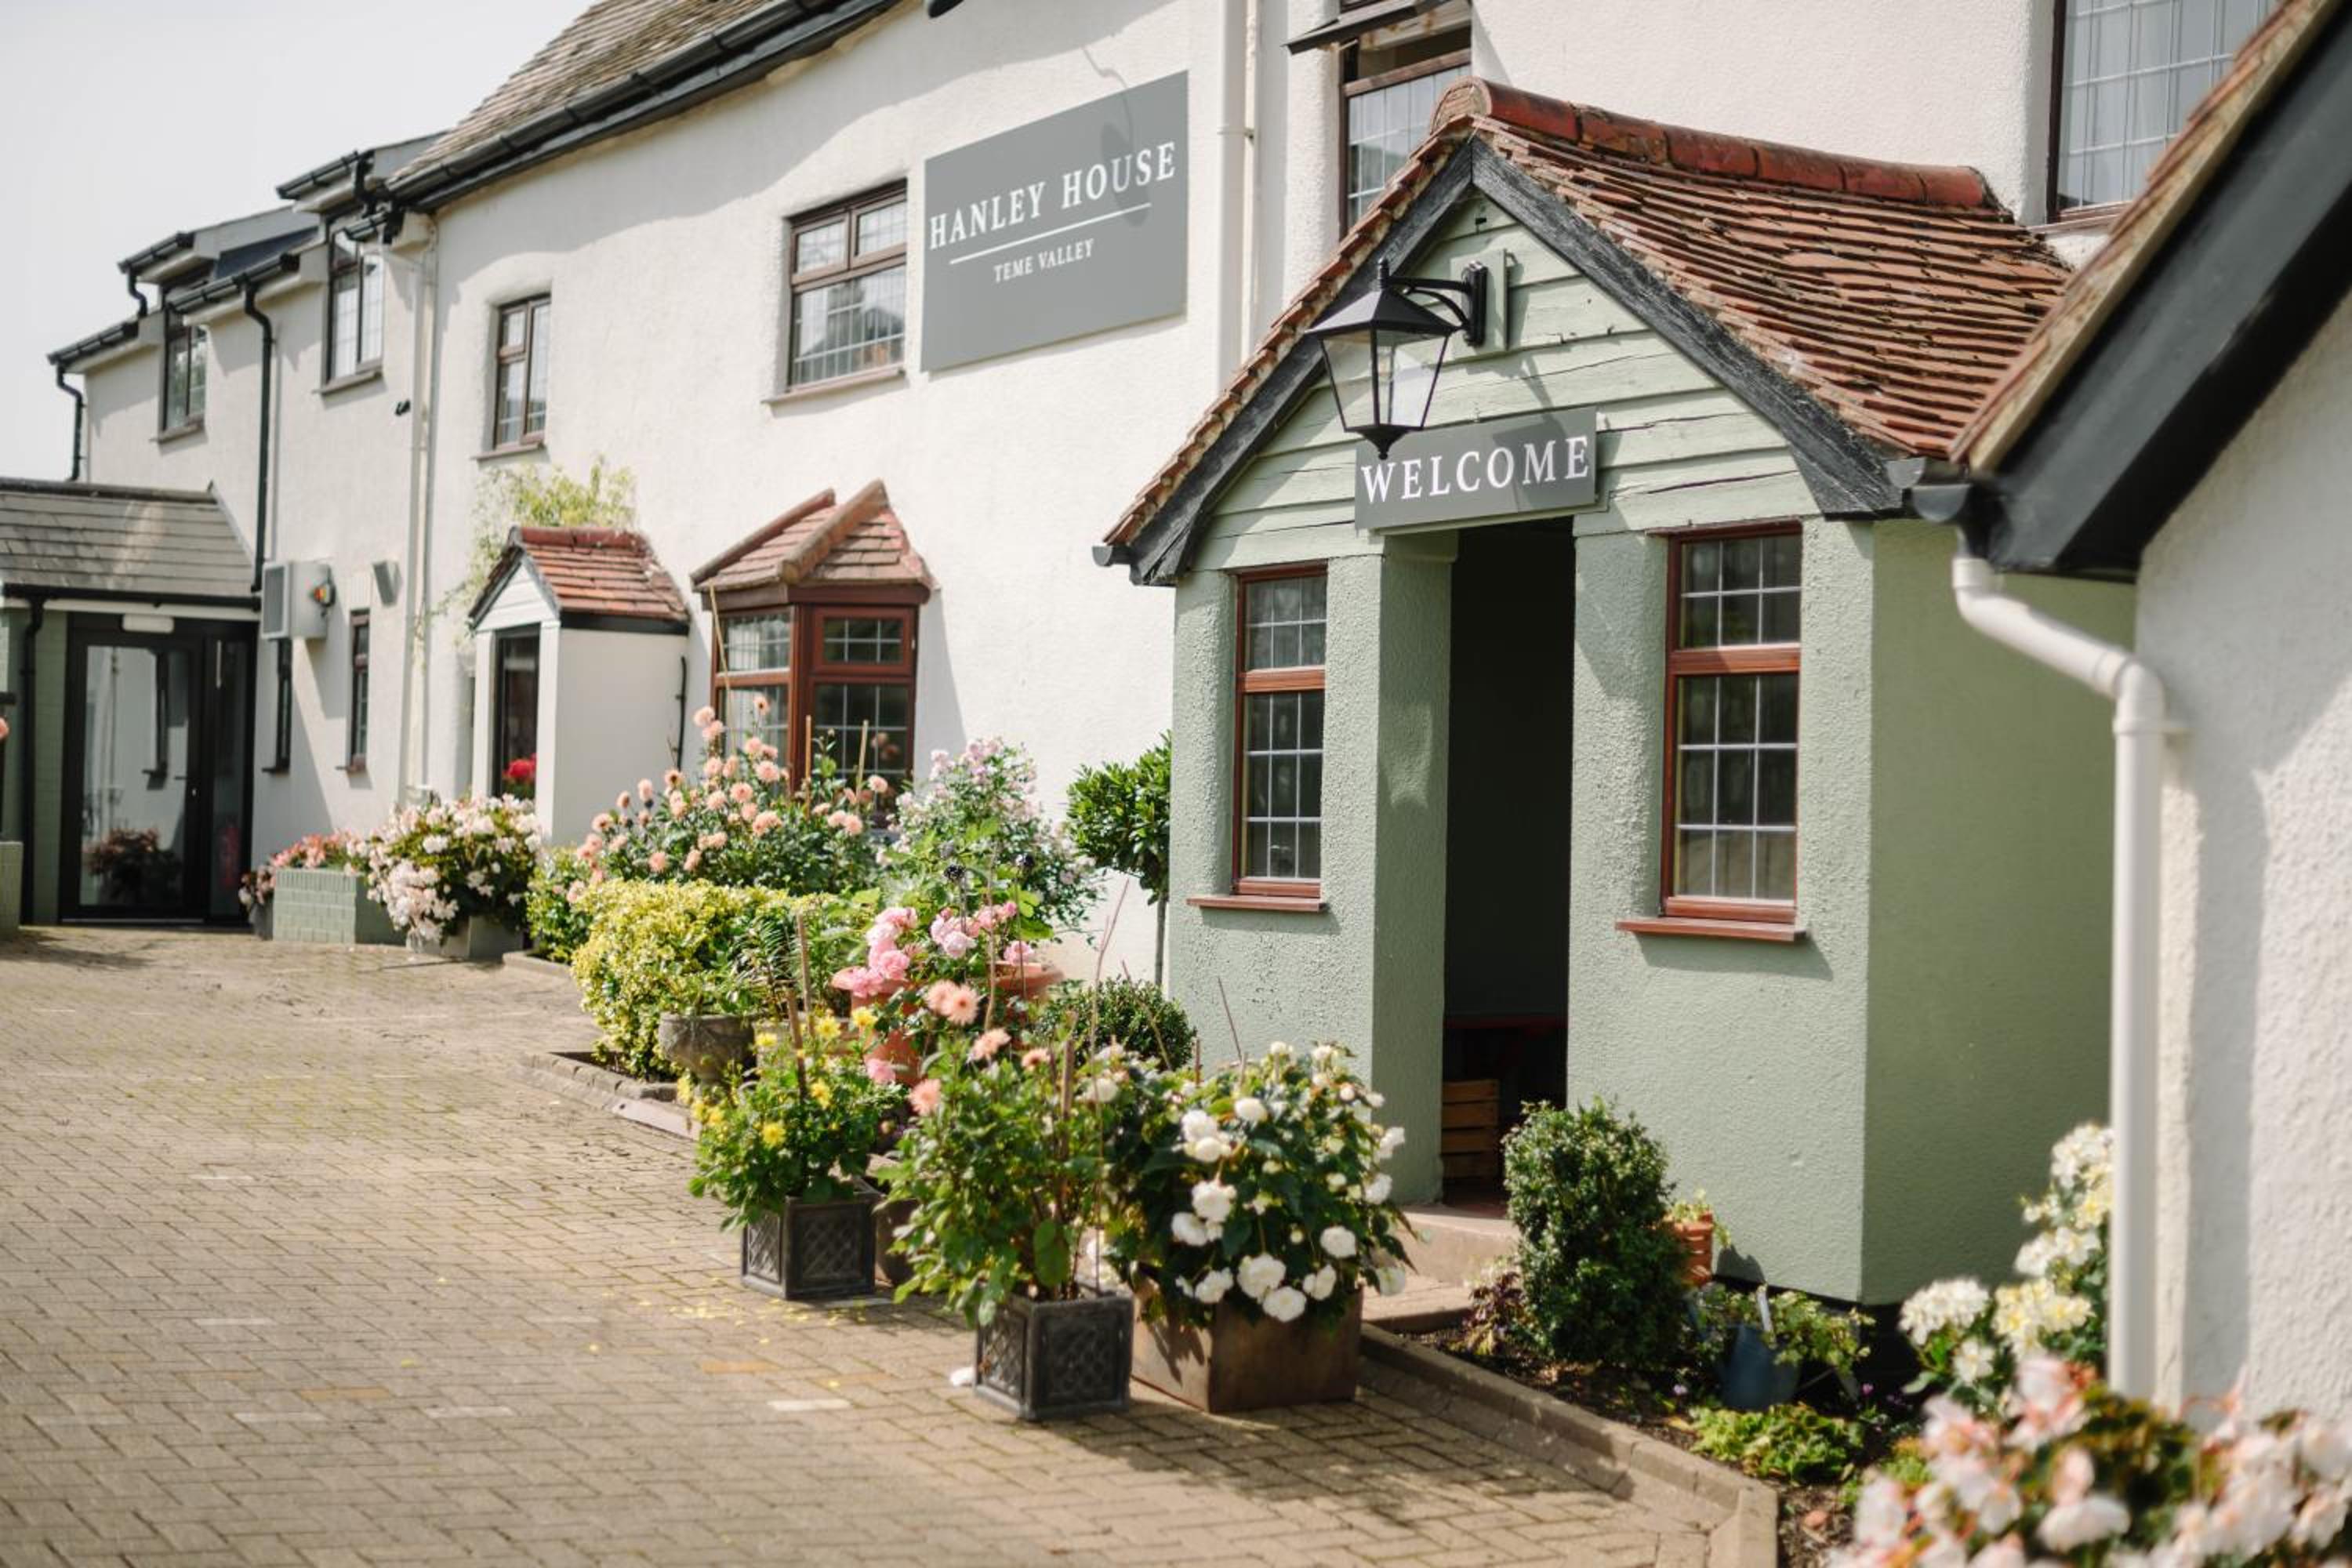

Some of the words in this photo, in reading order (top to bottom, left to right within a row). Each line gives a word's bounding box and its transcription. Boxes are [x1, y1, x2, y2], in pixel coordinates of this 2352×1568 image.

[929, 181, 1046, 250] HANLEY
[1061, 142, 1175, 209] HOUSE
[993, 256, 1033, 283] TEME
[1038, 238, 1094, 269] VALLEY
[1360, 435, 1589, 503] WELCOME
